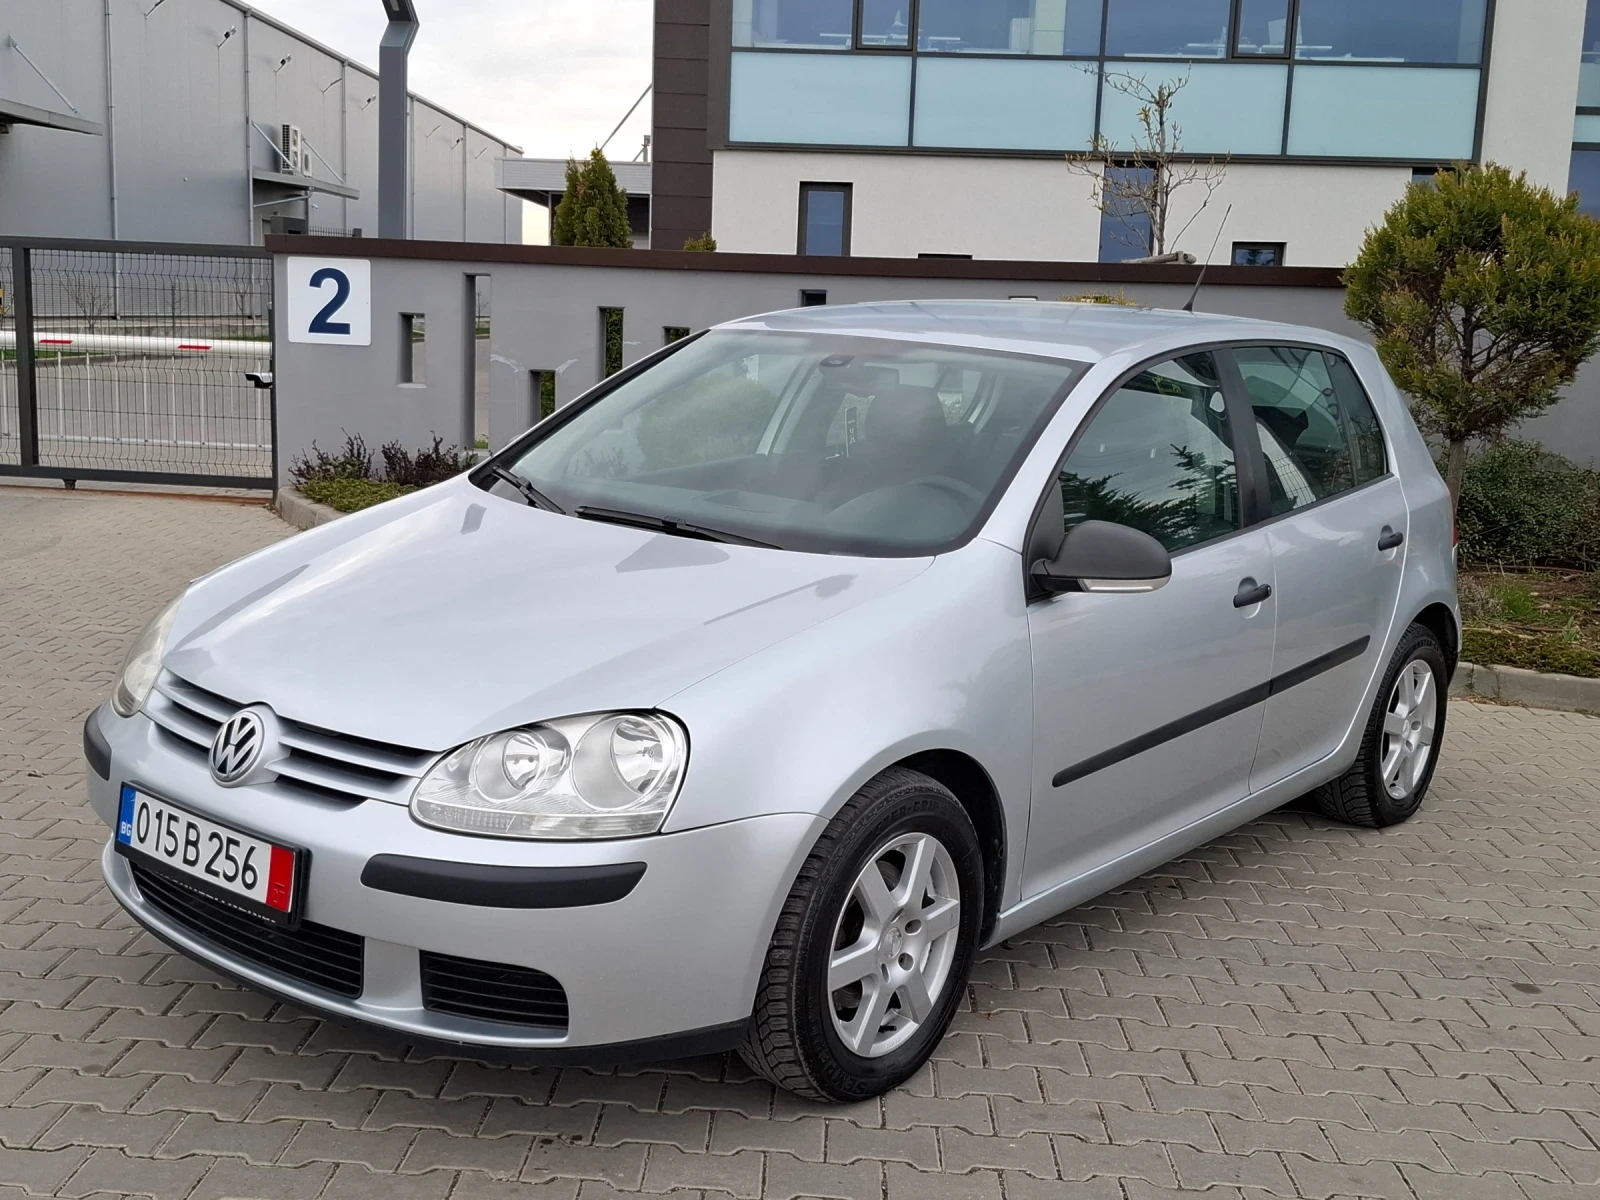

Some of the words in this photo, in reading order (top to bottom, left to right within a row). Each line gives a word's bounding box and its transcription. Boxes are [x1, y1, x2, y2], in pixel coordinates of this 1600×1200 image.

[308, 267, 351, 335] 2
[120, 820, 132, 837] BG
[136, 801, 259, 891] 015B256
